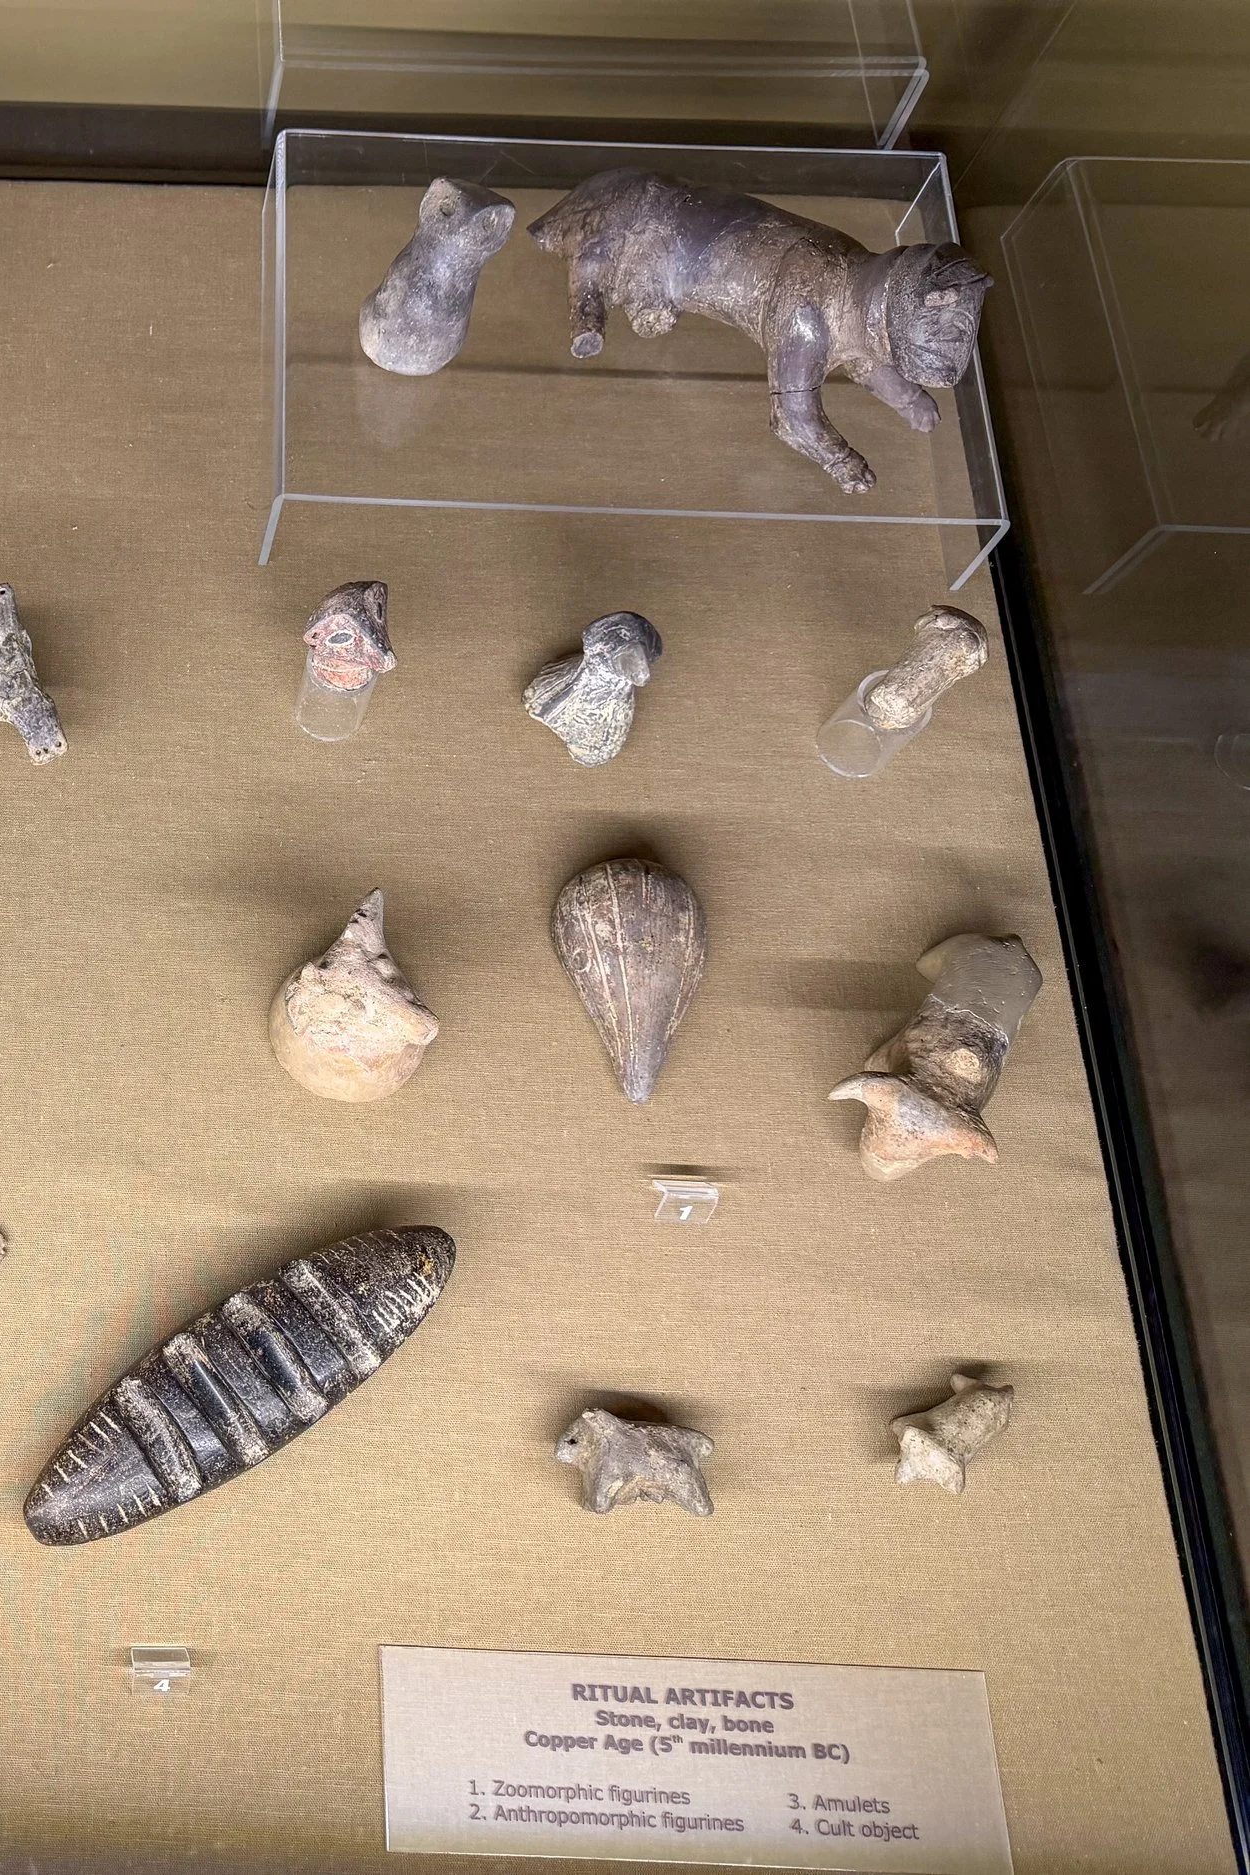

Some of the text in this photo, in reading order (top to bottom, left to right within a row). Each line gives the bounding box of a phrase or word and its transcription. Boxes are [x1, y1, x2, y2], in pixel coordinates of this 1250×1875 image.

[679, 1205, 693, 1221] 1
[153, 1678, 171, 1692] 4
[571, 1683, 795, 1710] RITUAL ARTIFACTS
[595, 1709, 775, 1734] Stone, clay, bone
[524, 1730, 850, 1764] Copper Age (5th millennium BC)
[468, 1779, 691, 1806] 1. Zoomorphic figurines
[787, 1792, 891, 1814] 3. Amulets
[468, 1803, 745, 1833] 2. Anthropomorphic figurines
[790, 1817, 920, 1842] 4. Cult object
